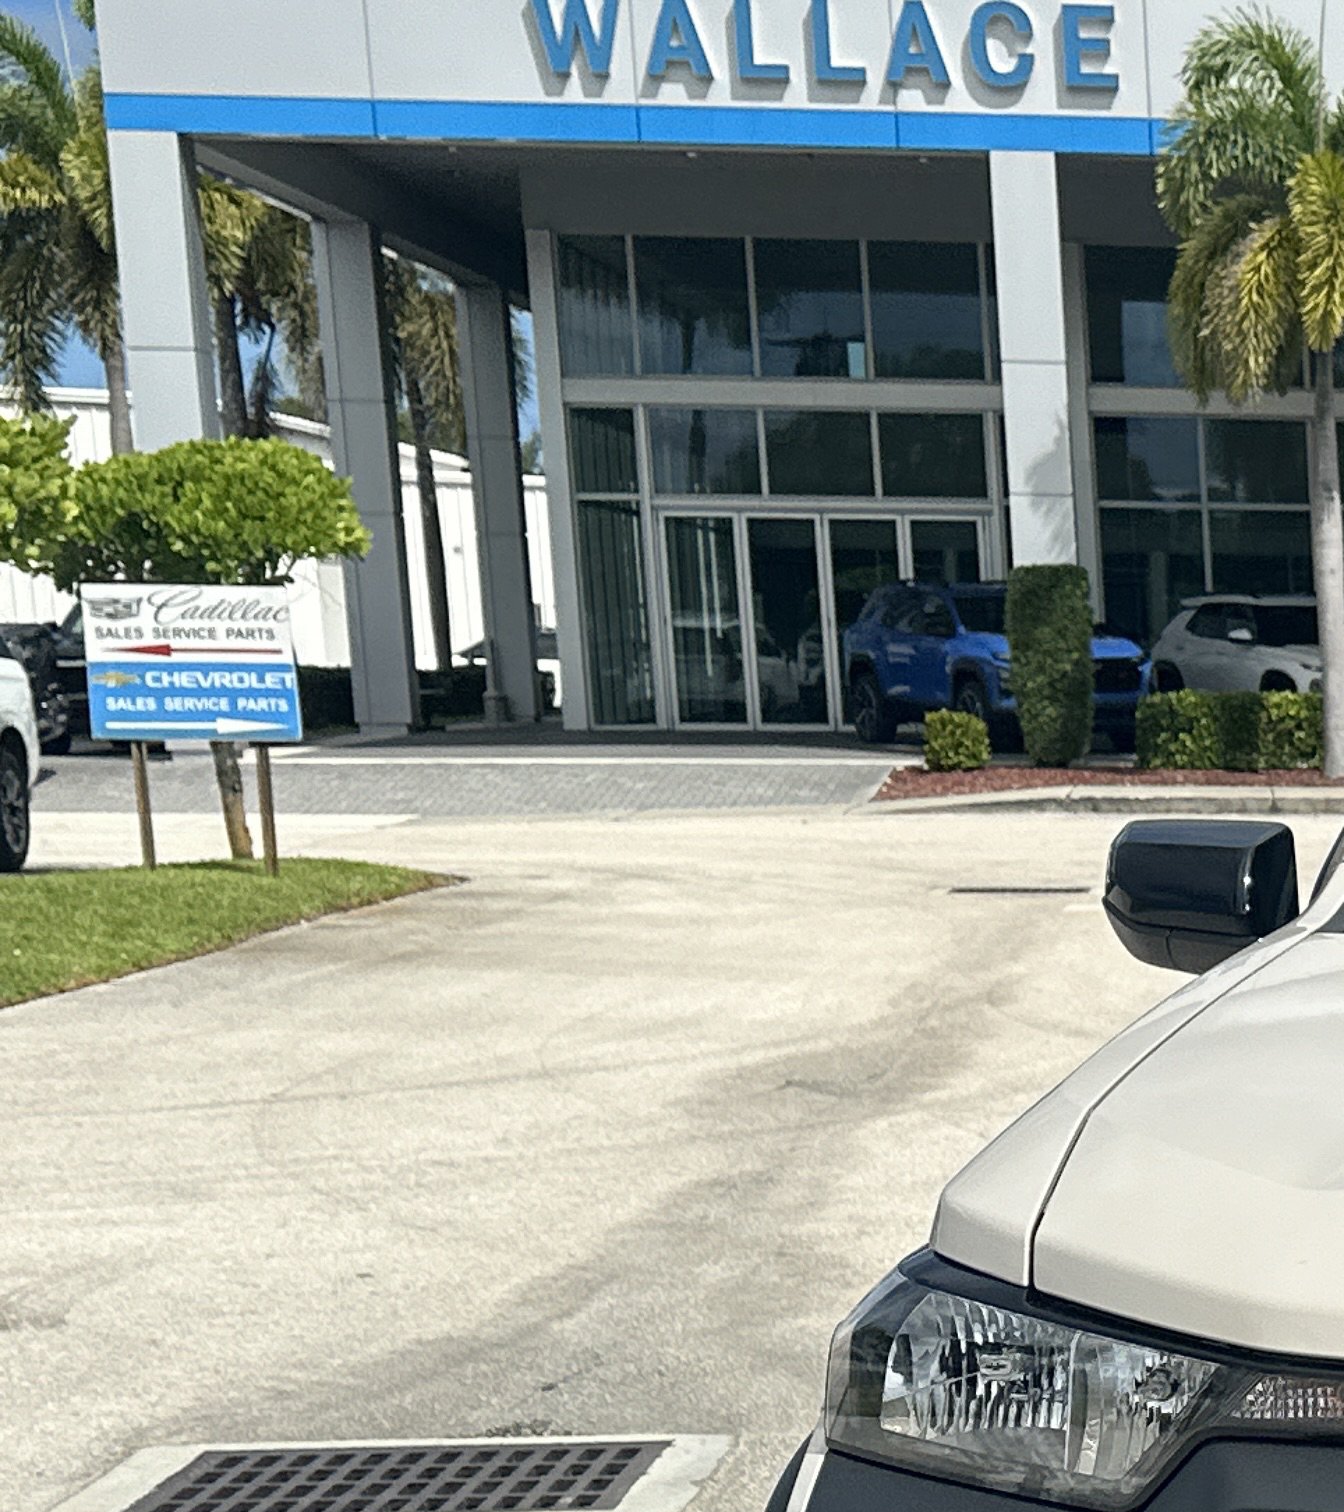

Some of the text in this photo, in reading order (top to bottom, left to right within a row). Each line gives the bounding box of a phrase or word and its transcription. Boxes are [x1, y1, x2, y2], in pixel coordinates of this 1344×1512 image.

[531, 0, 1121, 91] WALLACE
[147, 586, 291, 626] Cadillac
[95, 626, 275, 641] SALES SERVICE PARTS
[144, 671, 295, 689] CHEVROLET
[106, 696, 289, 713] SALES SERVICE PARTS
